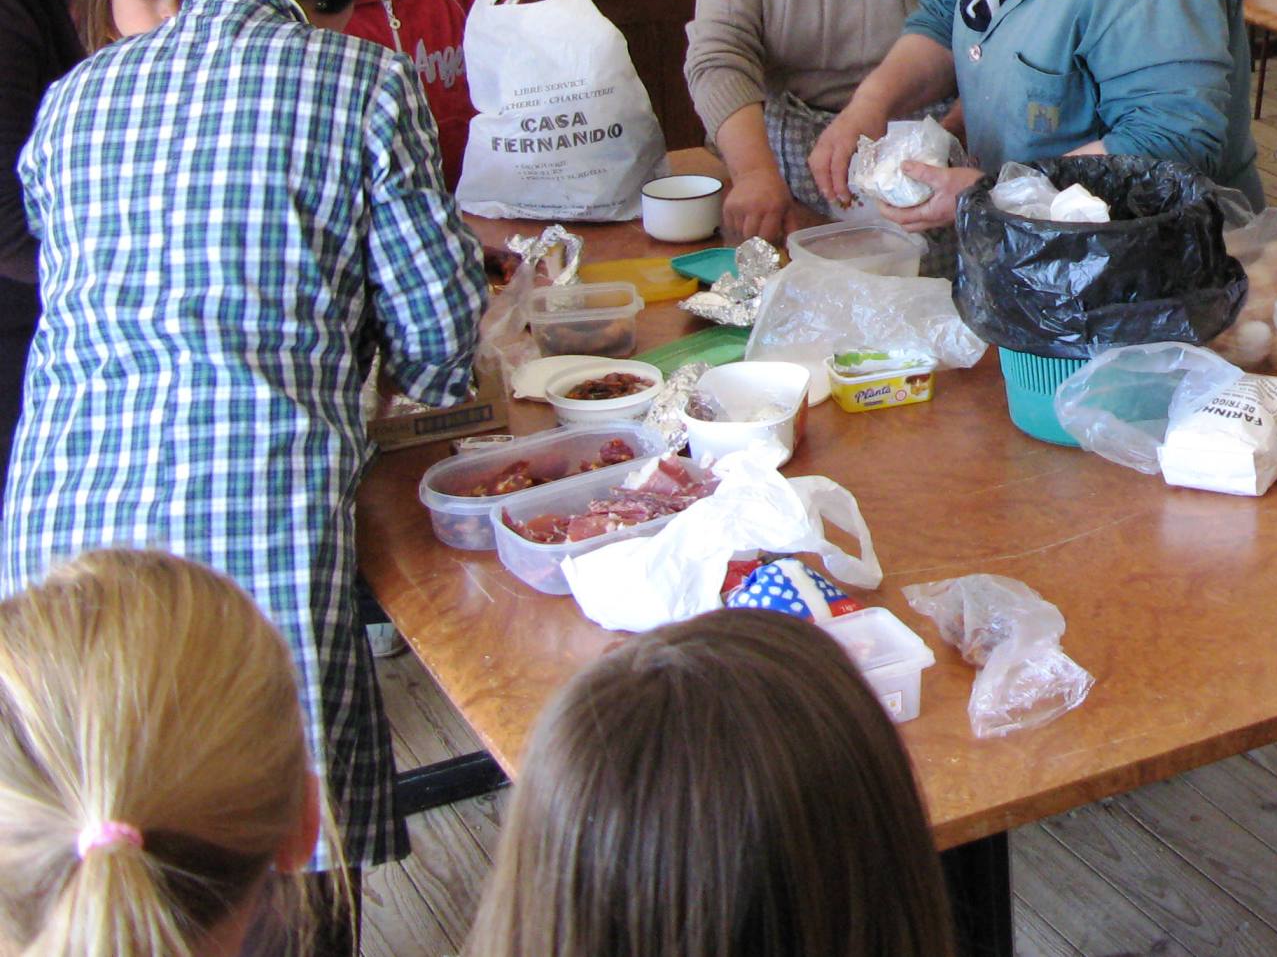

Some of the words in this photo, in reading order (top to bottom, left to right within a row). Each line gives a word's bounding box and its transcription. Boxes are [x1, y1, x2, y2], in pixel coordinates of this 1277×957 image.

[521, 111, 588, 133] CASA
[491, 122, 623, 154] FERNANDO
[855, 383, 891, 403] Planta
[1212, 397, 1242, 411] TRIGO
